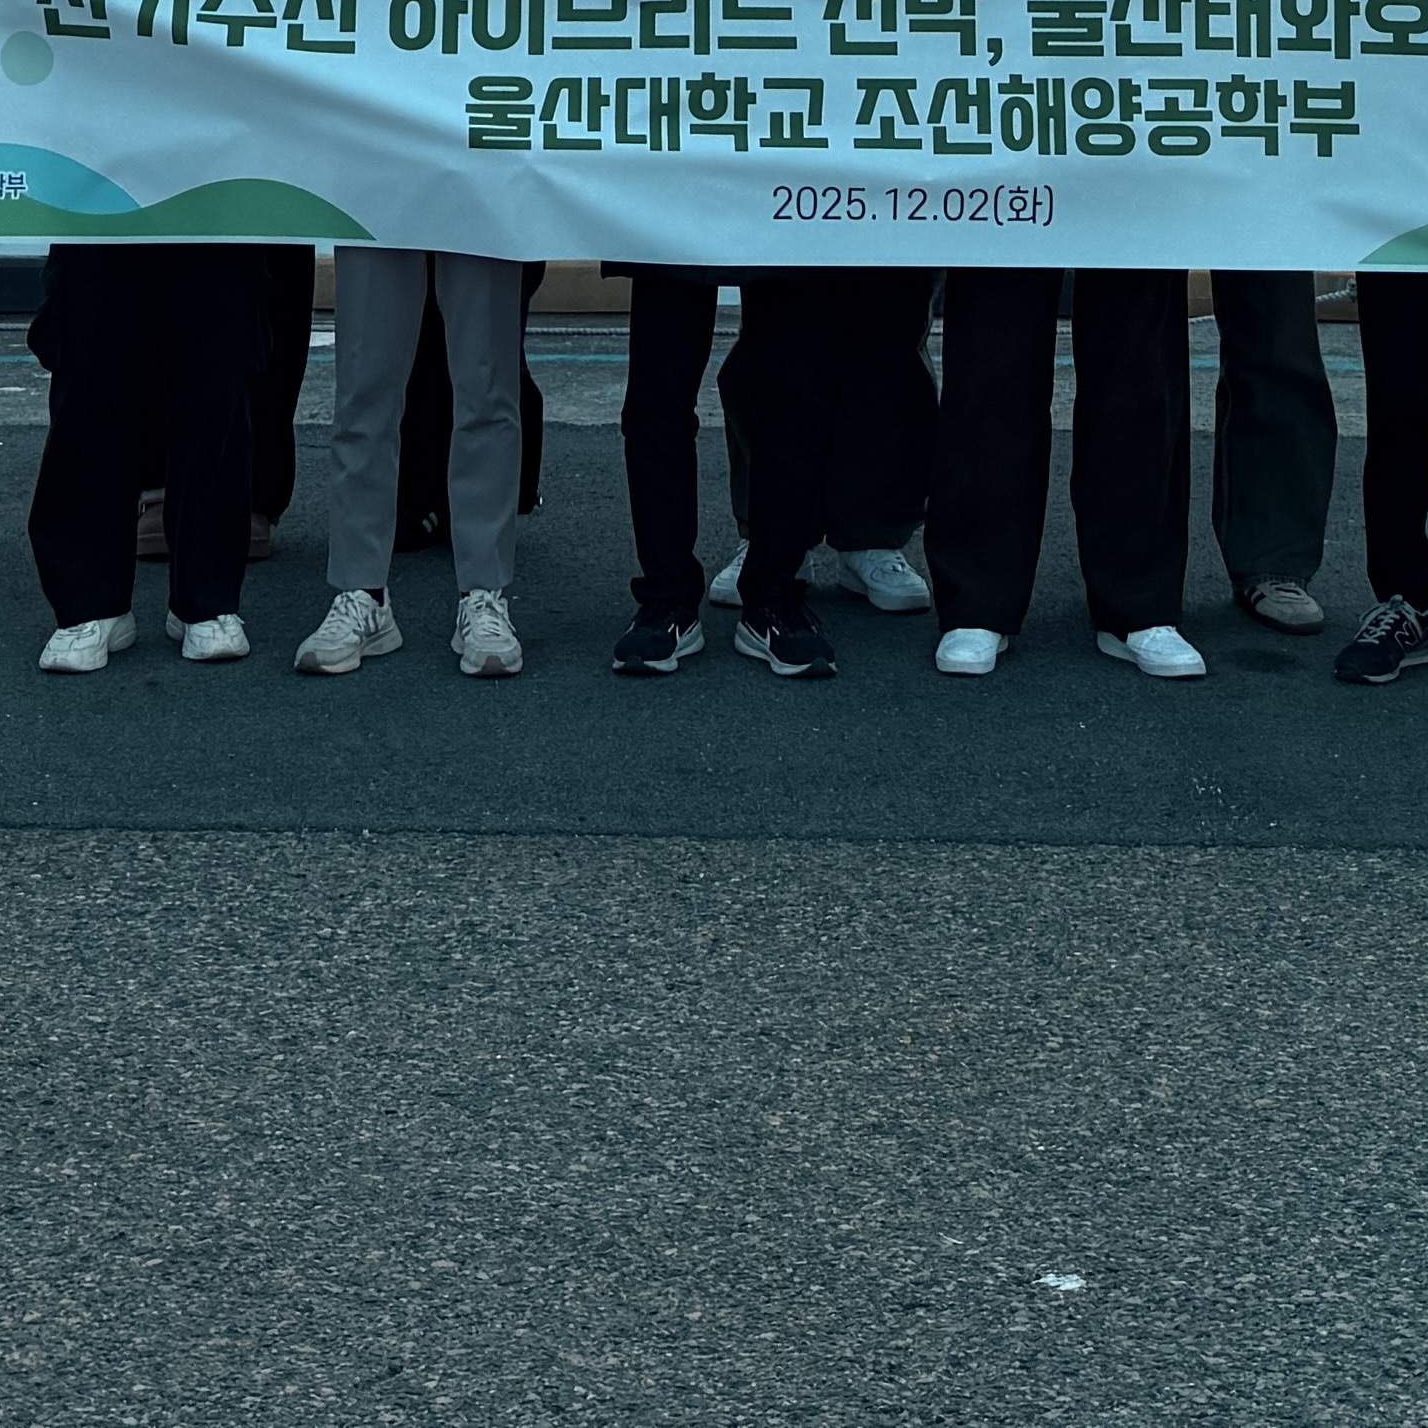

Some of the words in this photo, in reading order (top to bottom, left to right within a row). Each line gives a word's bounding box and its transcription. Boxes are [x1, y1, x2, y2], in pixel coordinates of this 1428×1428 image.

[465, 72, 829, 153] 울산대학교
[853, 74, 1361, 158] 조선해양공학부
[772, 184, 1054, 227] 2025.12.02(화)
